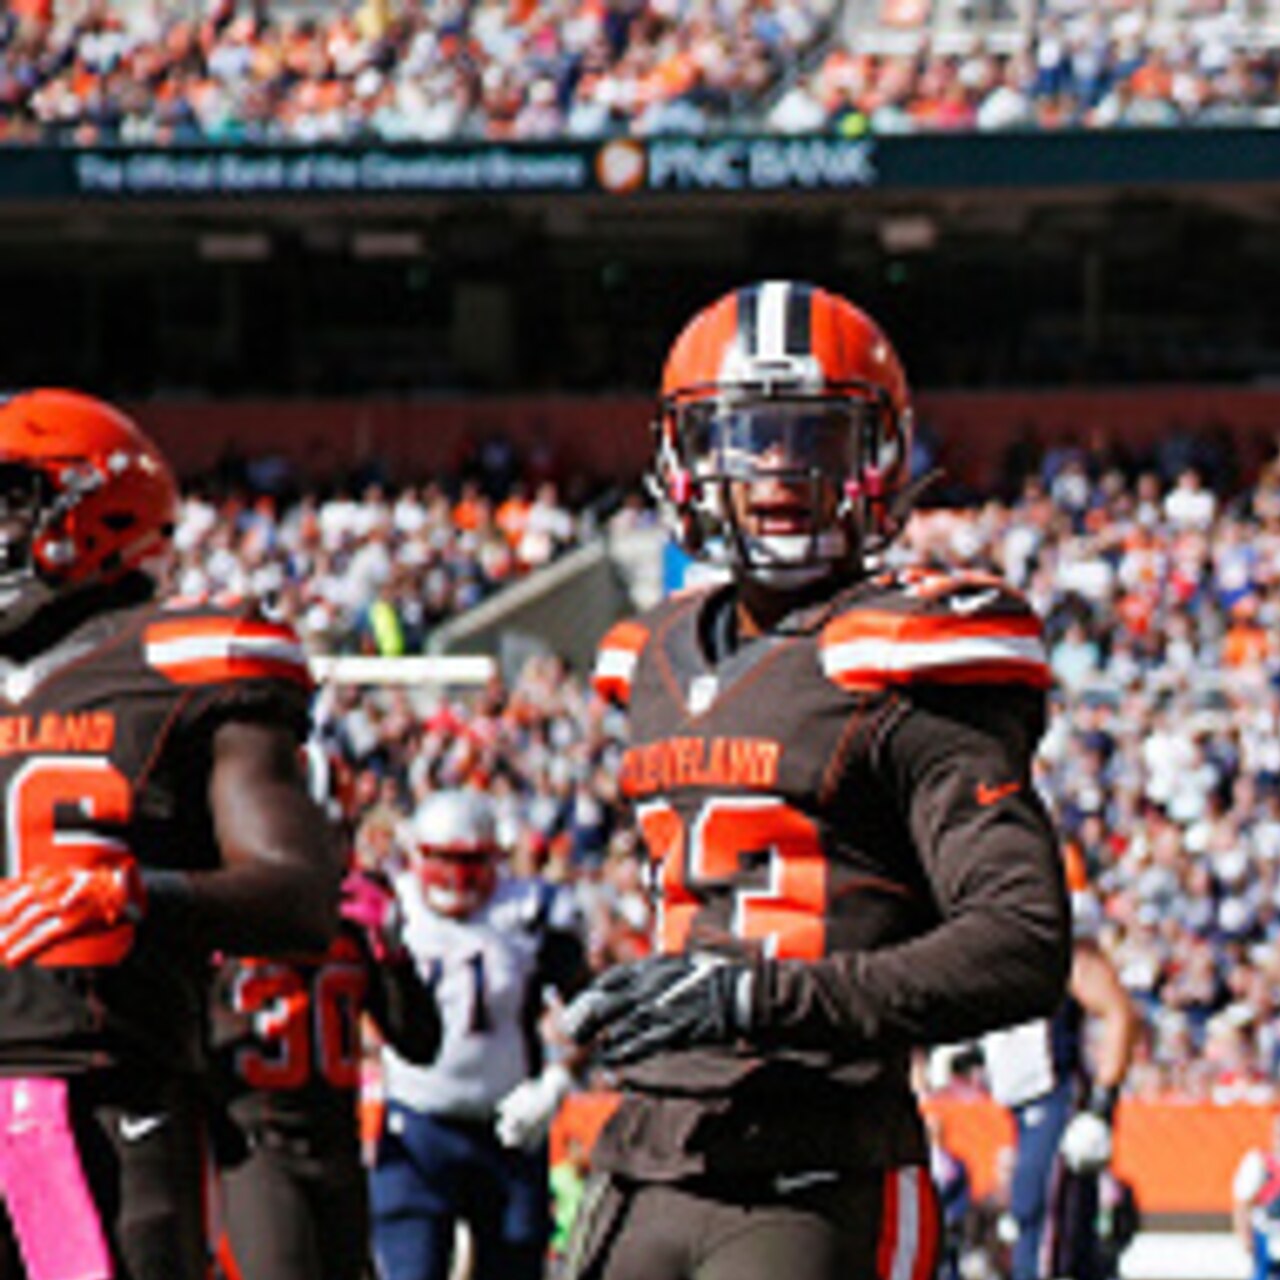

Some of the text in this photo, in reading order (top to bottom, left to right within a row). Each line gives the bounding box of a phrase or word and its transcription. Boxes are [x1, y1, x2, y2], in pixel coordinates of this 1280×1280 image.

[648, 138, 878, 190] PNC BANK
[0, 710, 116, 757] ELAND
[233, 955, 366, 1090] 30
